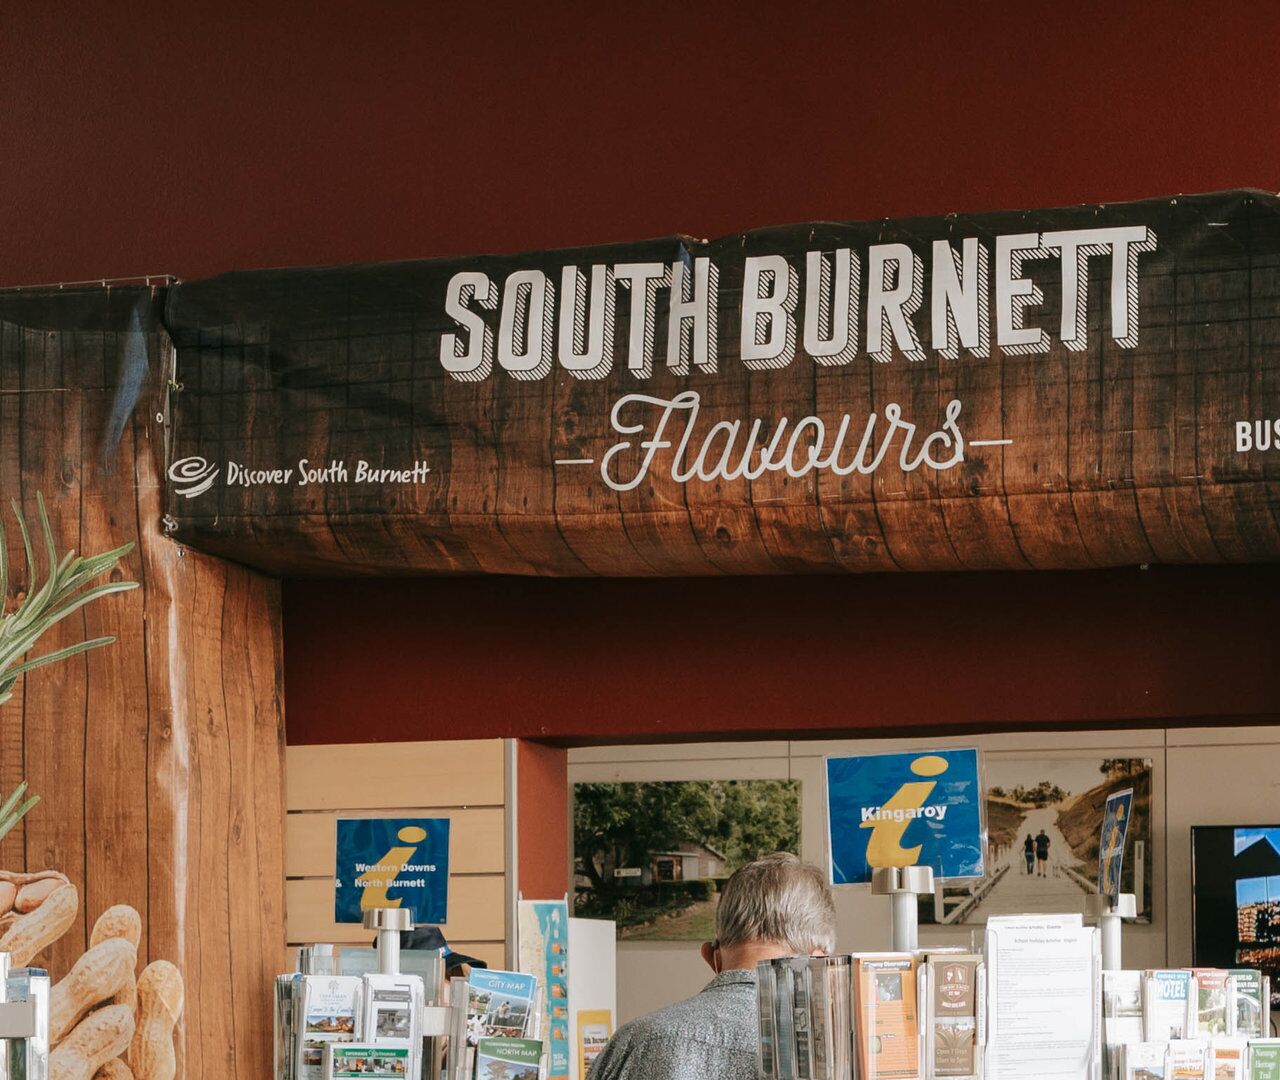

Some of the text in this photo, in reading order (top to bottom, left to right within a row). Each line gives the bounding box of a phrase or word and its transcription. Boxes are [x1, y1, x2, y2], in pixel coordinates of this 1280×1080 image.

[439, 226, 1158, 382] SOUTH BURNETT
[600, 391, 965, 492] Flavours
[225, 459, 431, 487] Discover South Burnett
[860, 804, 947, 823] Kingaroy
[355, 863, 436, 872] Western Downs
[354, 878, 383, 888] North
[386, 878, 426, 888] Burnett
[488, 980, 525, 991] CITY MAP
[496, 1048, 538, 1058] NORTH MAP
